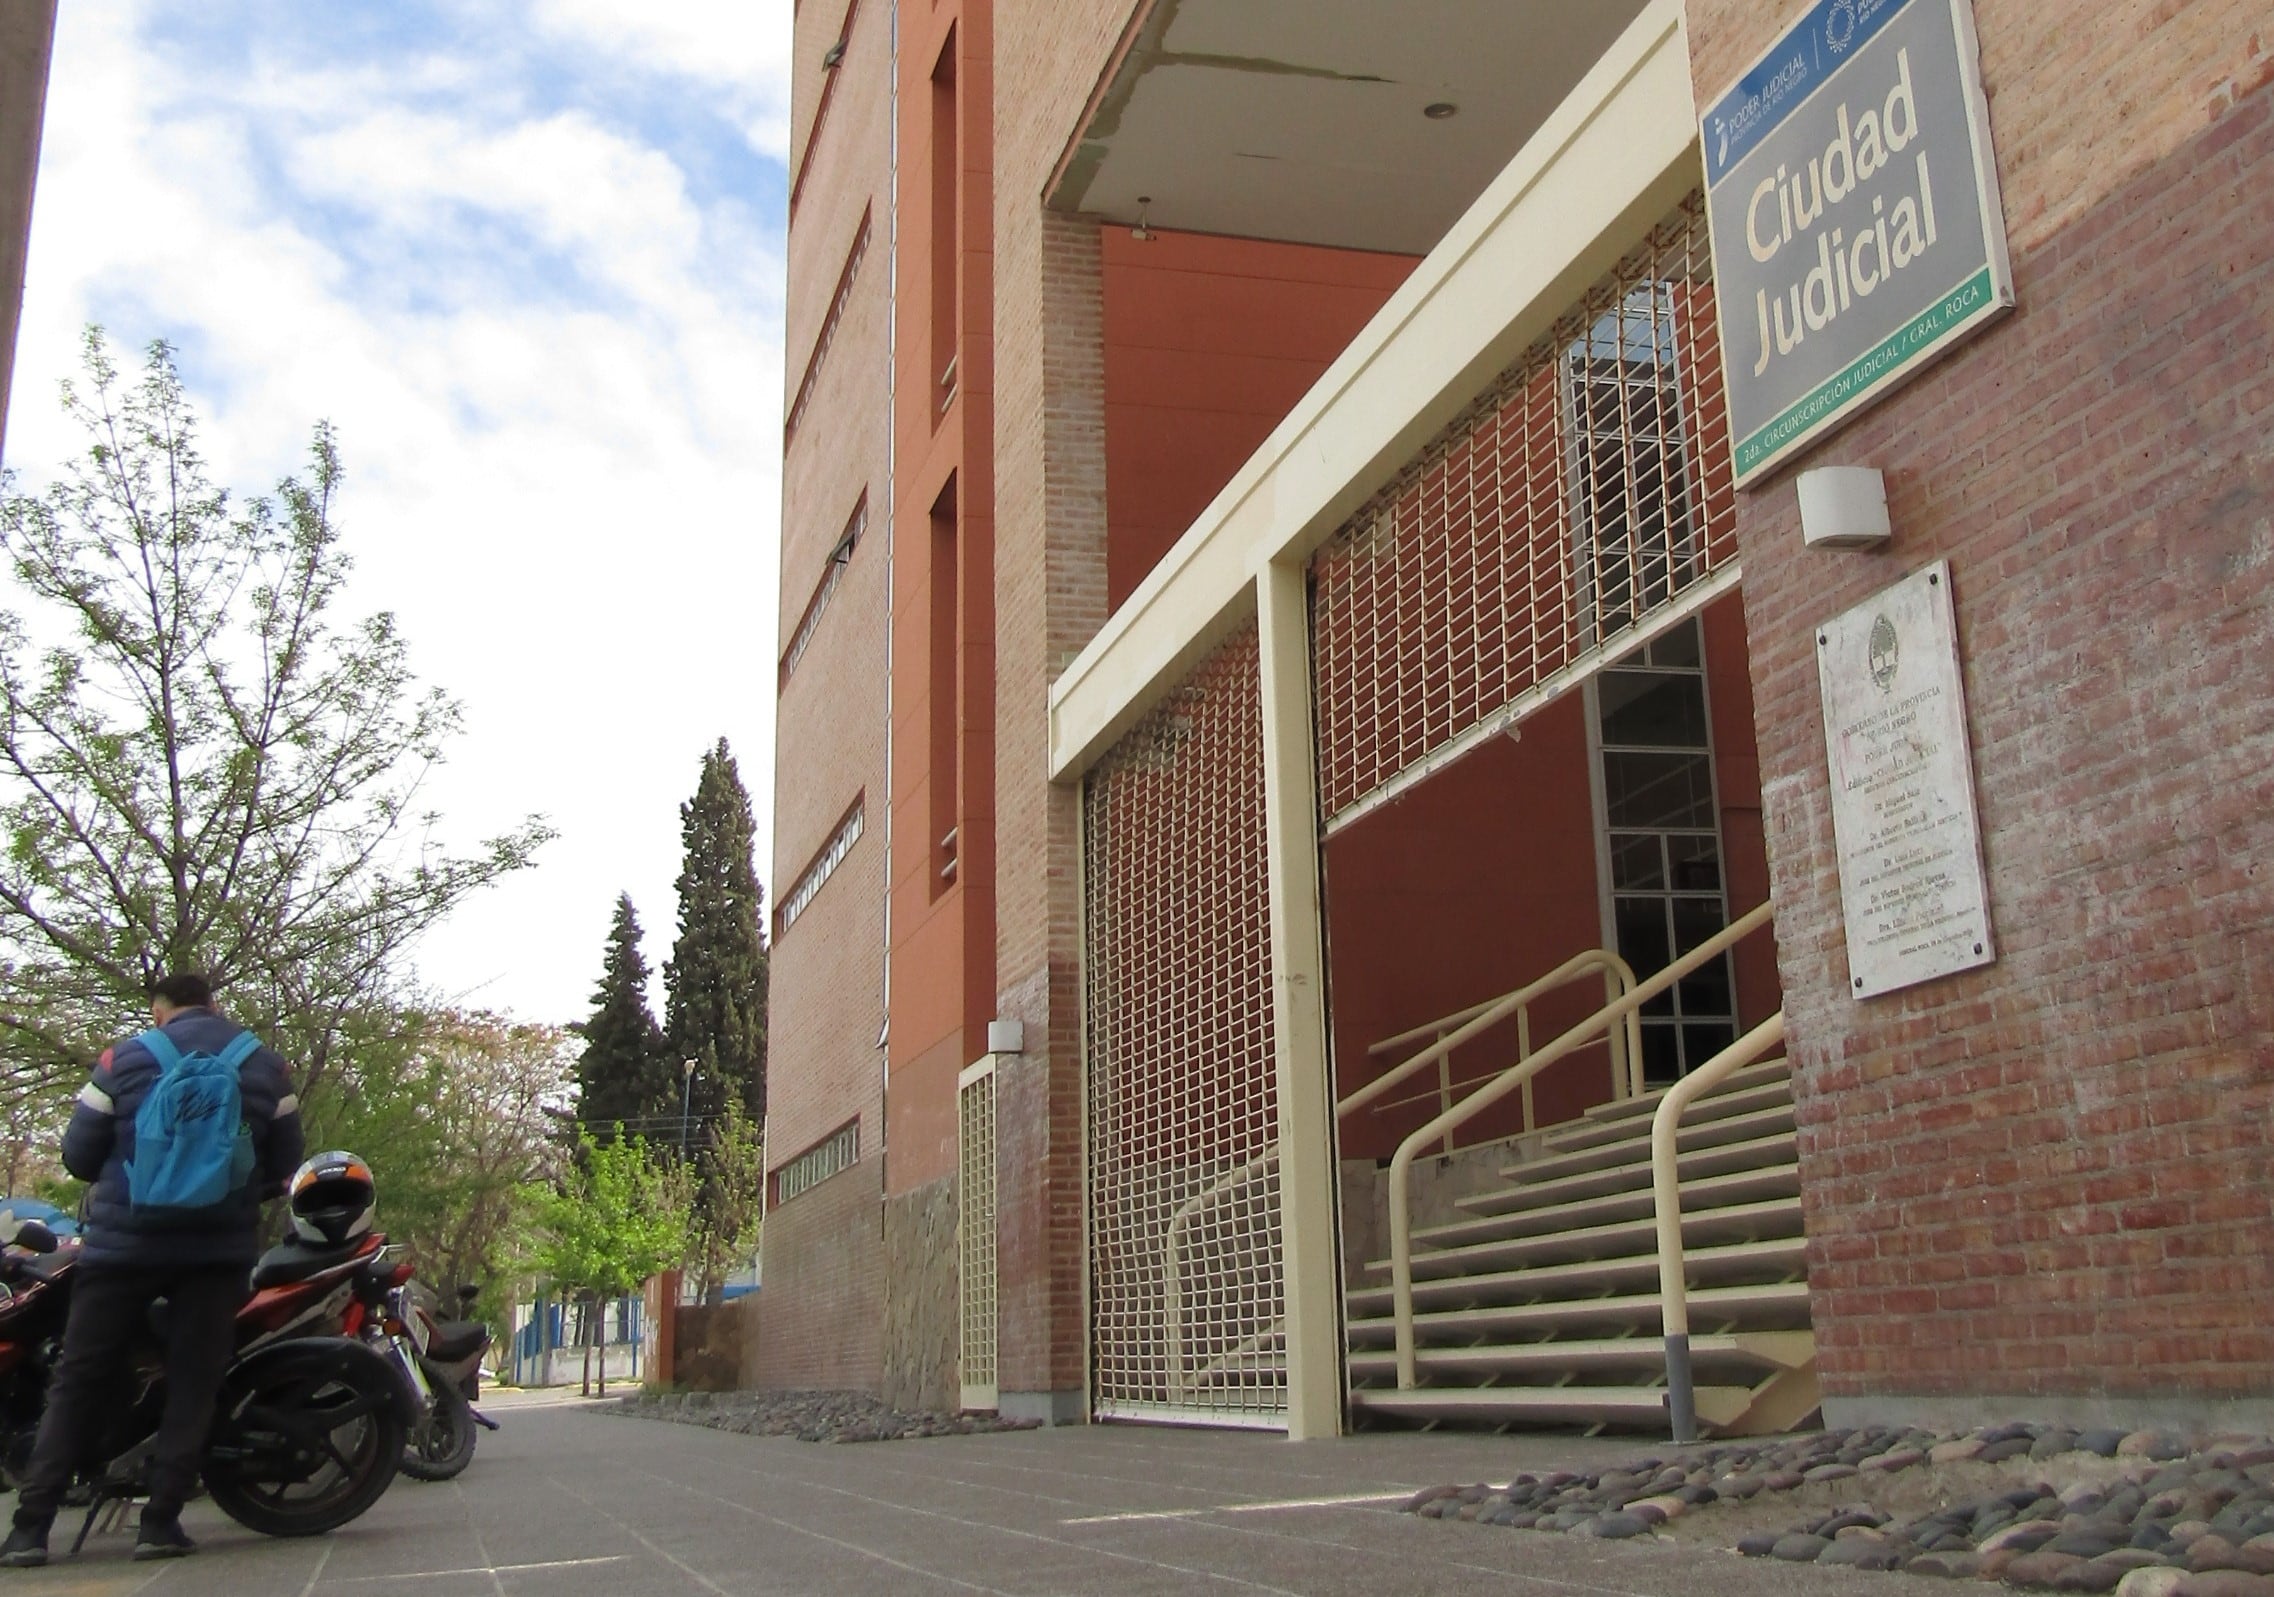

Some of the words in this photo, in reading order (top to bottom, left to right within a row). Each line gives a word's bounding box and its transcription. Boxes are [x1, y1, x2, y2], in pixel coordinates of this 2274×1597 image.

[1729, 95, 1760, 134] PODER
[1762, 53, 1805, 102] JUDICIAL
[1746, 47, 1918, 262] Ciudad
[1762, 101, 1771, 115] DE
[1785, 67, 1808, 94] NEGRO
[1754, 150, 1937, 377] Judicial
[1744, 444, 1760, 463] 2da.
[1764, 377, 1851, 448] CIRCUNSCRIPCIÓN
[1853, 345, 1899, 386] JUDICIAL
[1910, 315, 1942, 343] GRAL.
[1945, 286, 1980, 319] ROCA
